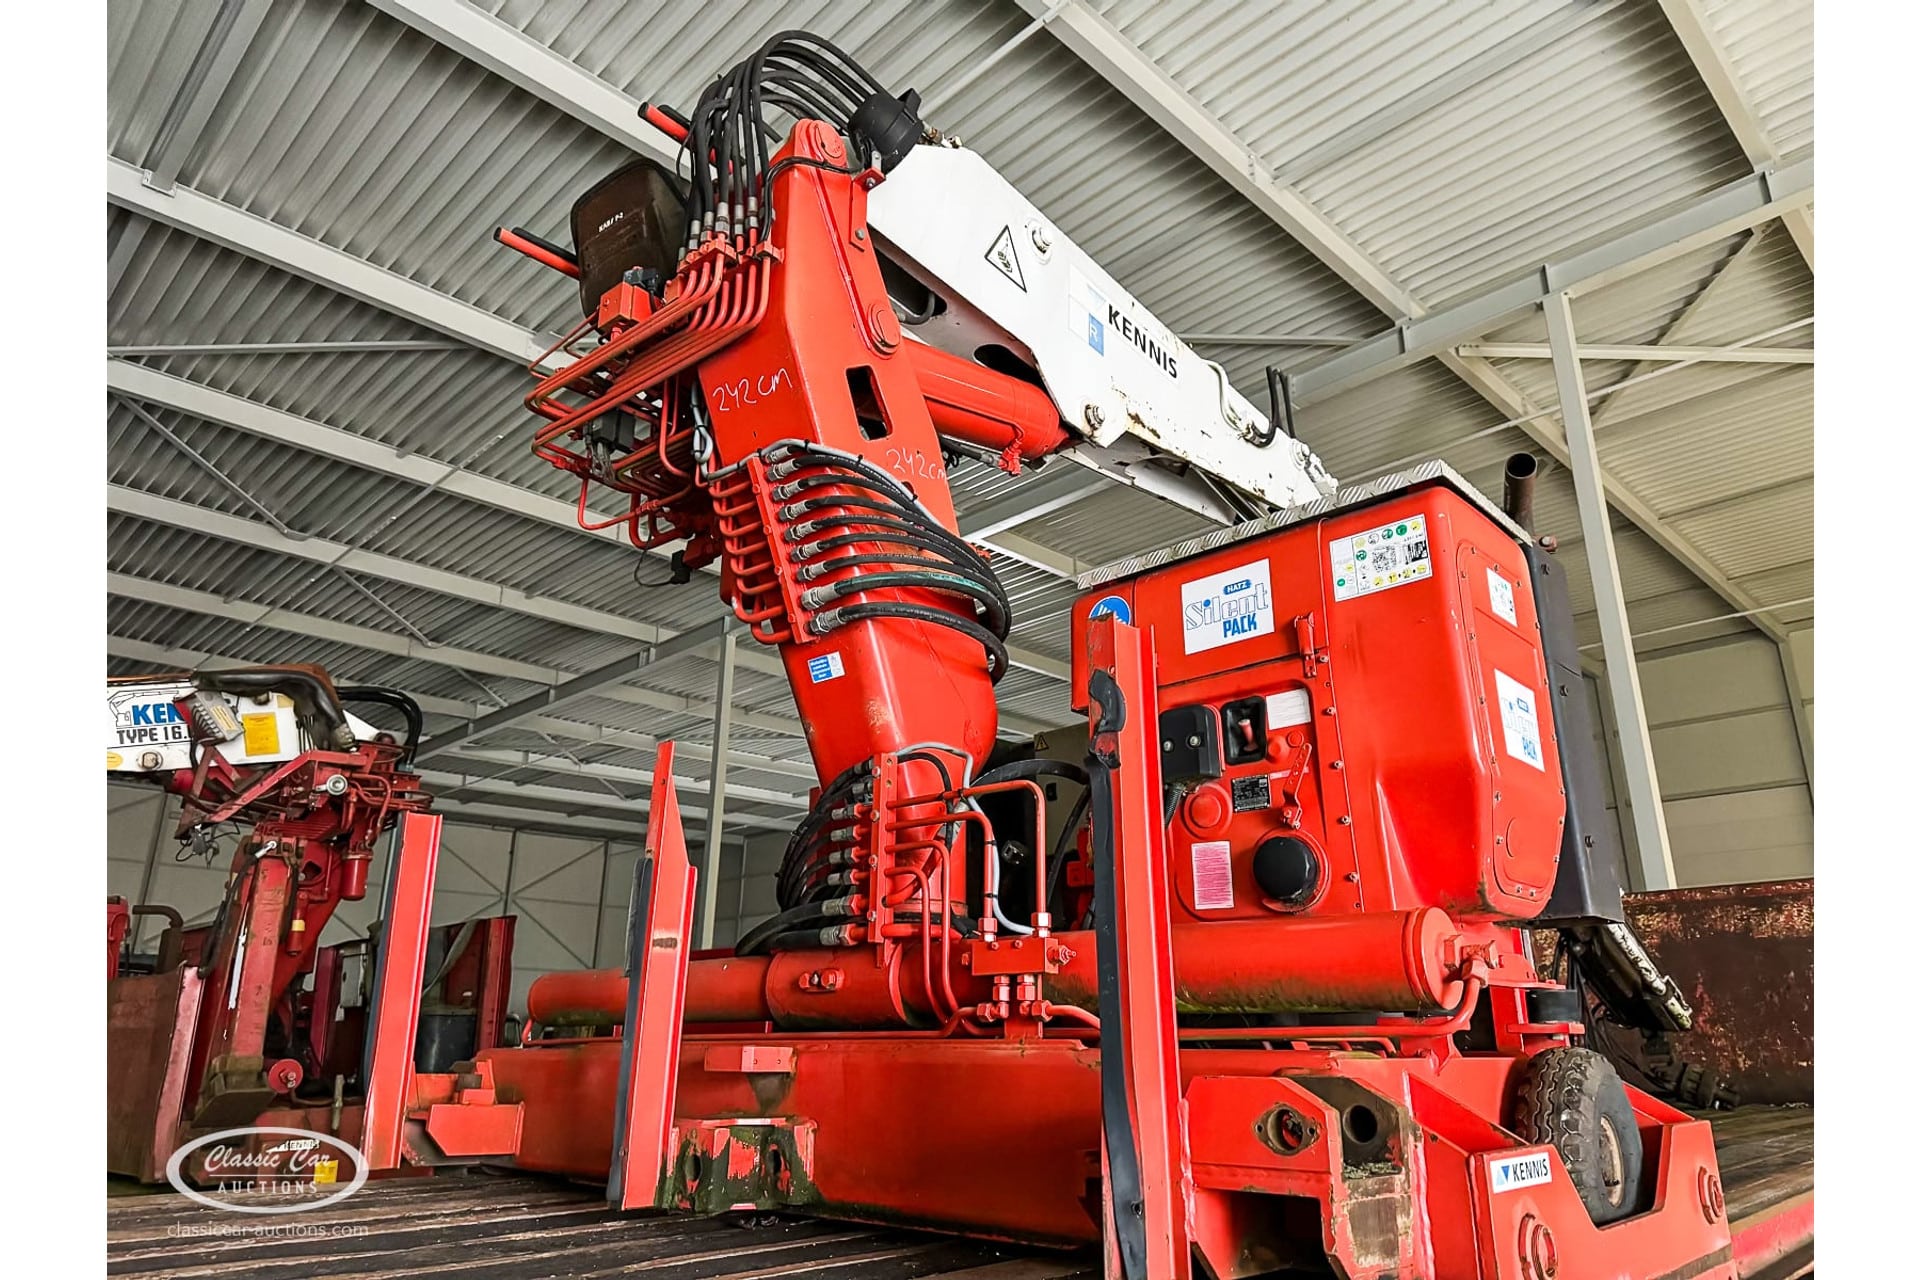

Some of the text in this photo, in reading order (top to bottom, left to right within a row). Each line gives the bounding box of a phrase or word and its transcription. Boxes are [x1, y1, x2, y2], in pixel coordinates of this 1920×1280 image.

[1108, 303, 1178, 379] KENNIS
[1226, 581, 1248, 594] HATZ
[1184, 582, 1270, 631] Silent
[1222, 612, 1257, 638] PACK
[116, 728, 159, 745] TYPE
[1512, 1158, 1549, 1182] KENNIS
